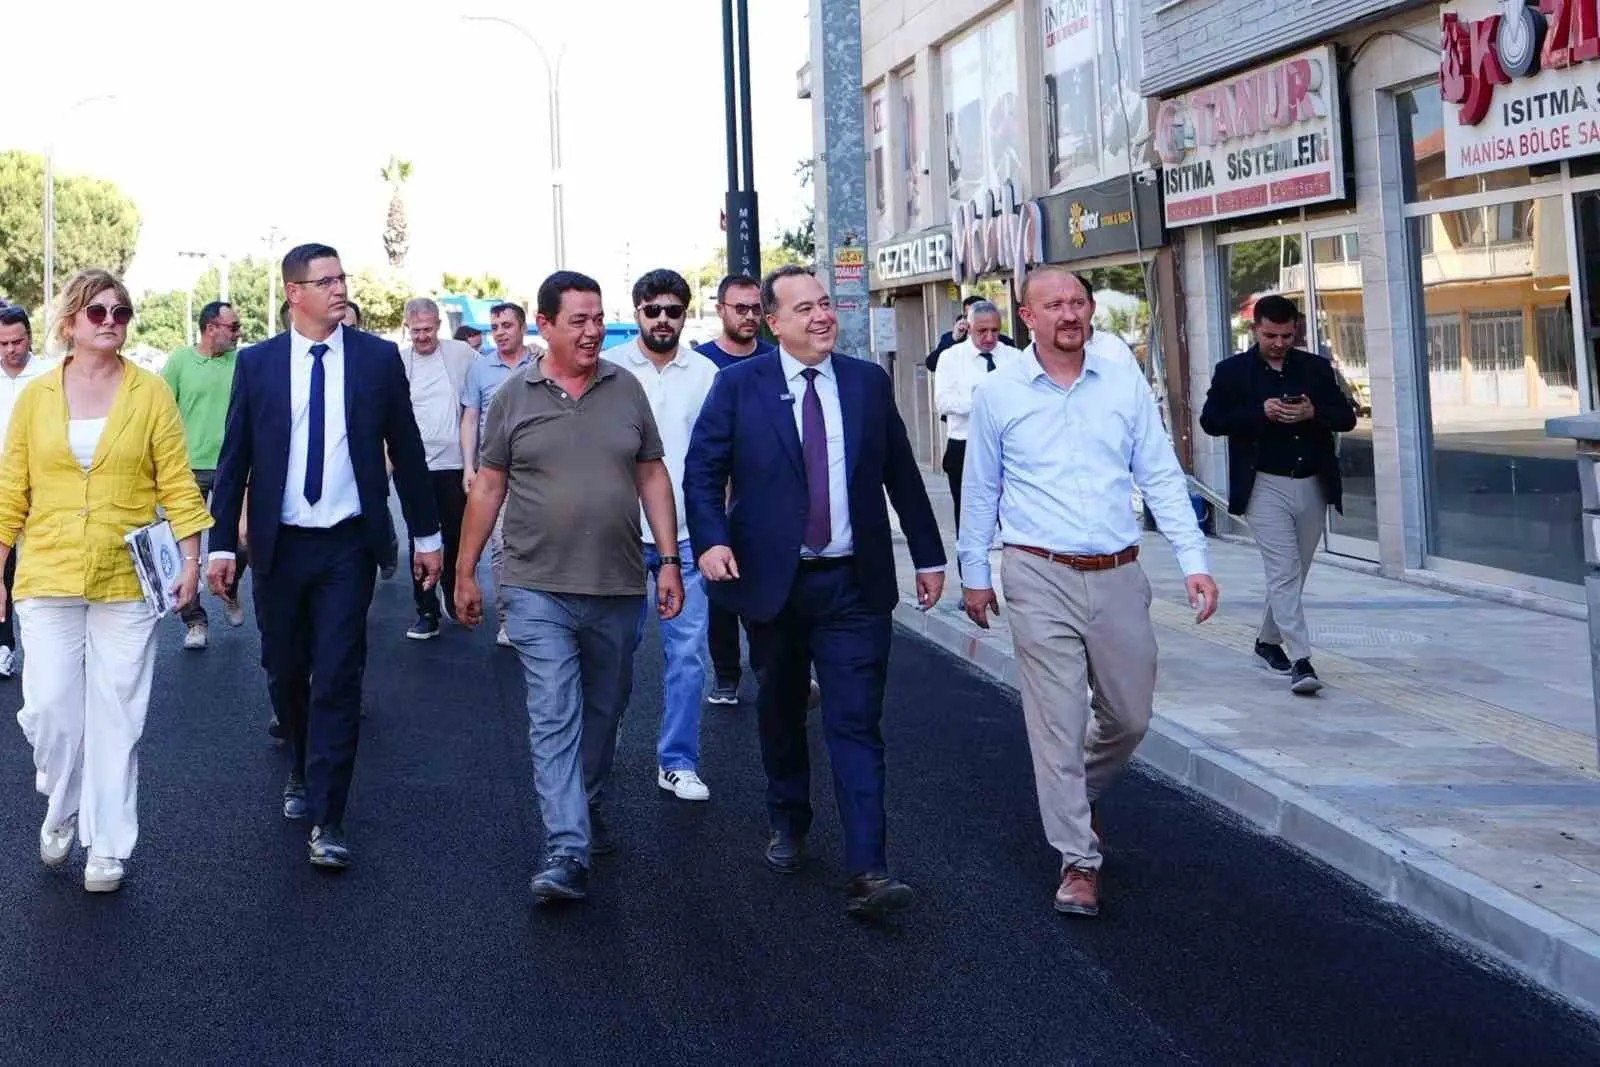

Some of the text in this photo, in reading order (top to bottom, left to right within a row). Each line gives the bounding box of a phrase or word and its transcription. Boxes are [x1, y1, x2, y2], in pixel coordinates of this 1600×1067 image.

[1503, 86, 1589, 127] ISITMA
[1165, 128, 1330, 195] ISITMA SİSTEMLERİ
[1460, 135, 1516, 168] MANİSA
[1519, 125, 1572, 157] BÖLGE
[876, 234, 948, 281] GEZEKLER
